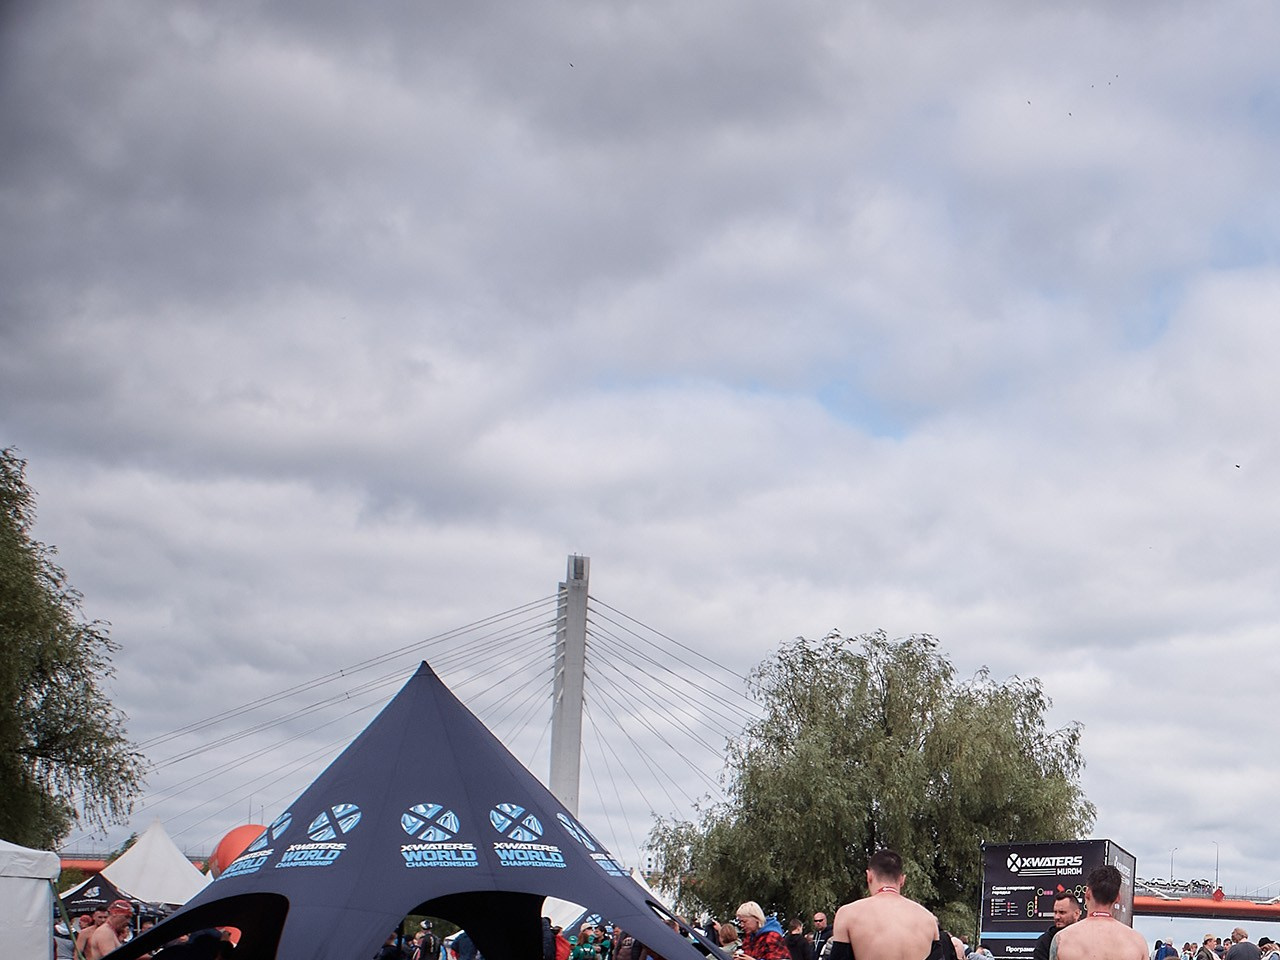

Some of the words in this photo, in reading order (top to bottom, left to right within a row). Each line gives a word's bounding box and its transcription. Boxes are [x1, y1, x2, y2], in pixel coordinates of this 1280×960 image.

[281, 849, 341, 862] WORLD
[401, 850, 478, 862] WORLD
[495, 849, 564, 862] WORLD
[406, 860, 479, 868] CHAMPIONSHIP
[501, 860, 567, 869] CHAMPIONSHIP
